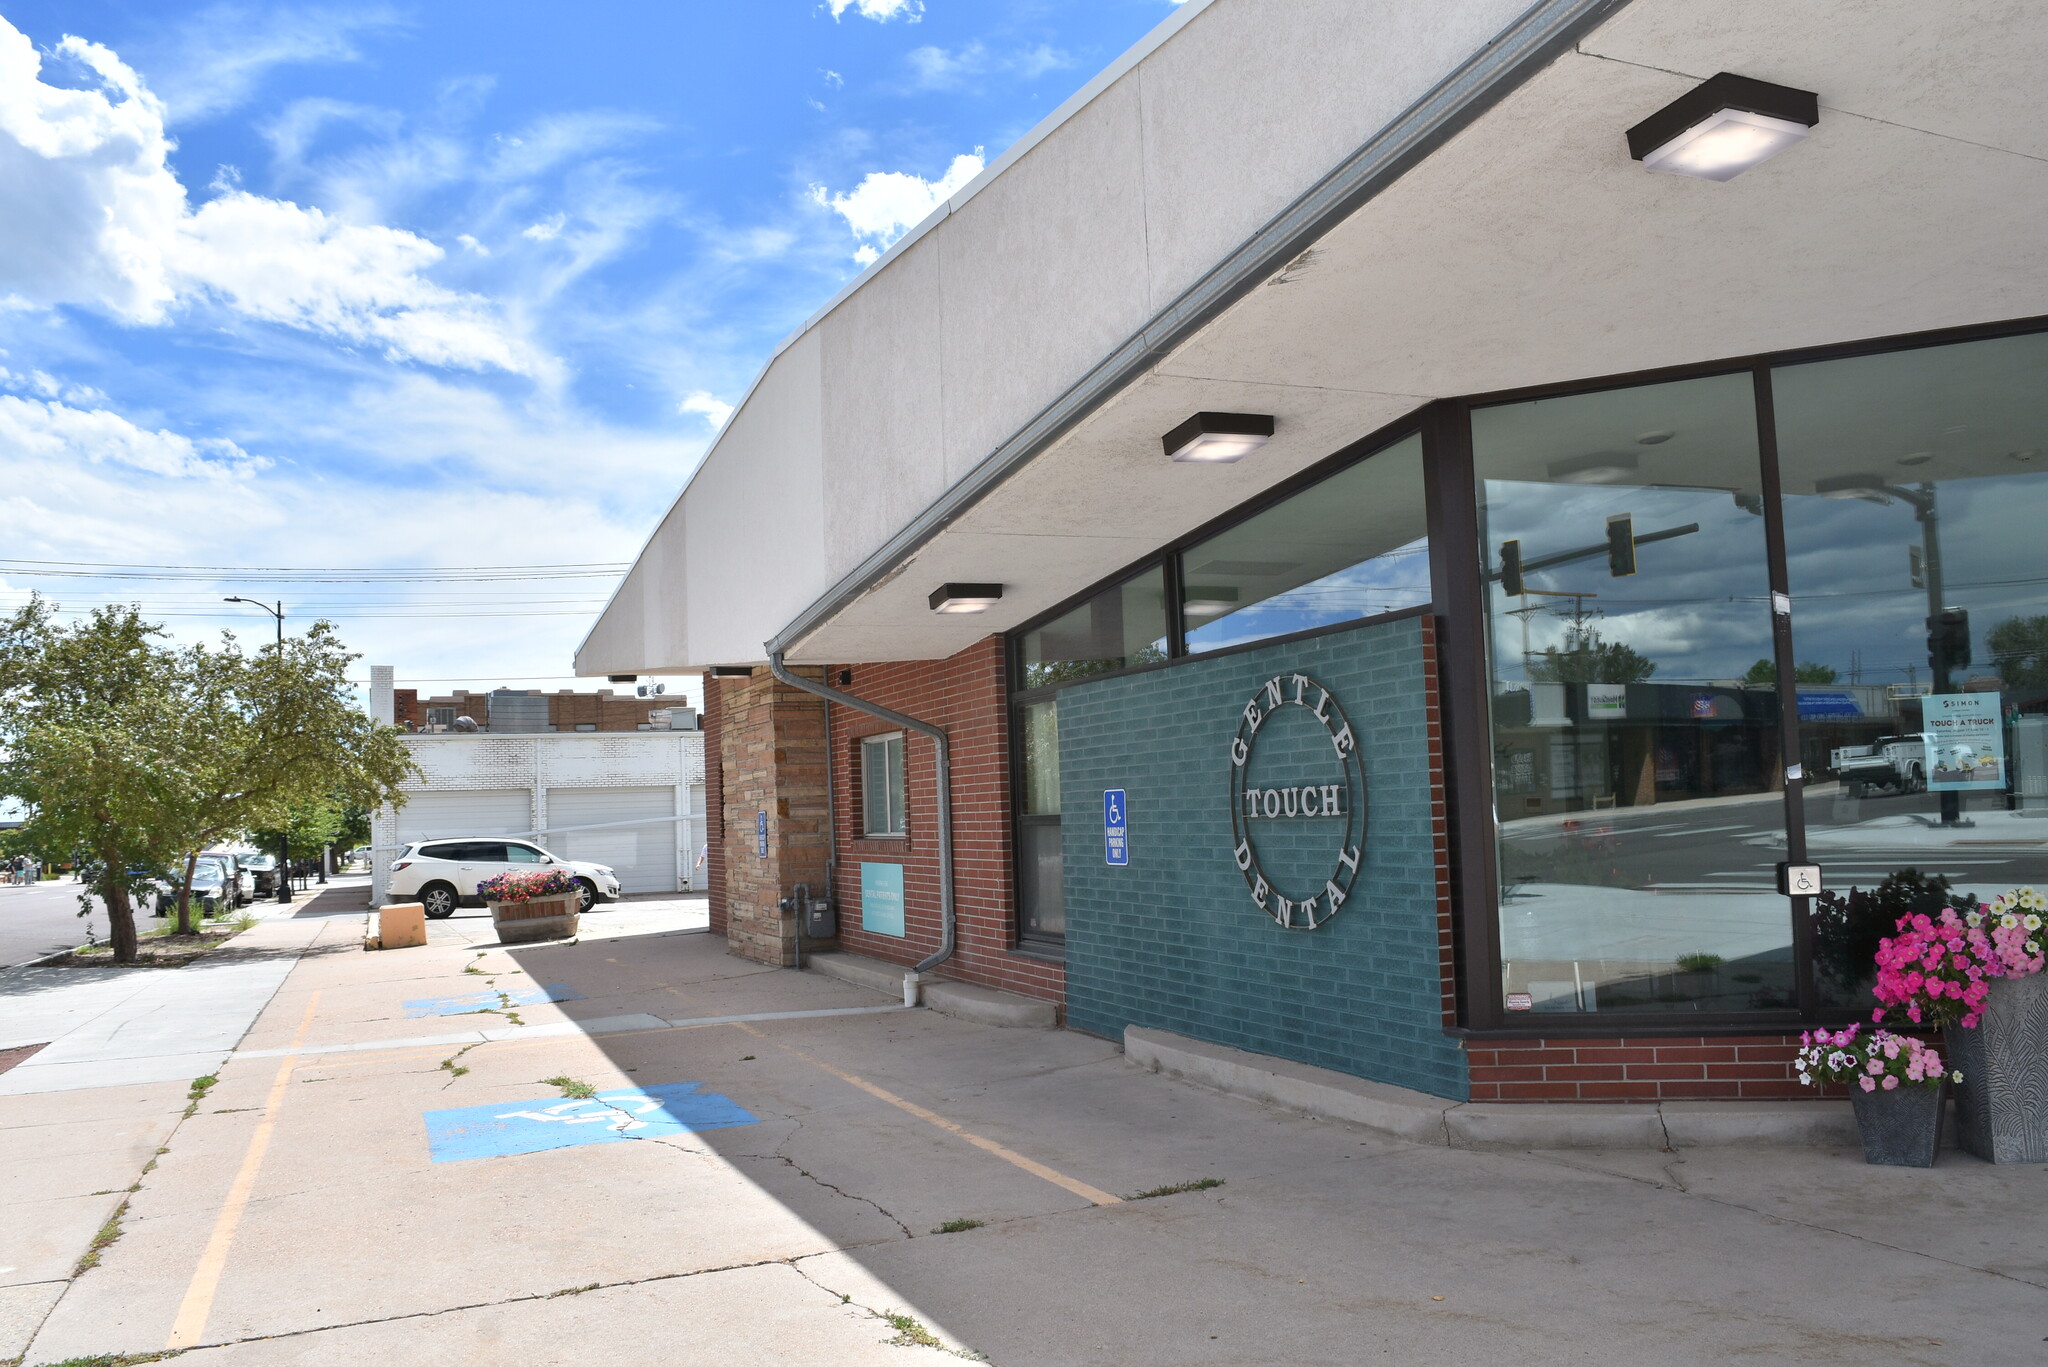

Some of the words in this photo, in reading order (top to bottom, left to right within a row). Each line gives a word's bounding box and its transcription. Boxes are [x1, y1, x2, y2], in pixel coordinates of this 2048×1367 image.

[1231, 673, 1355, 767] GENTLE
[1968, 718, 1994, 726] TRUCK
[1246, 784, 1341, 819] TOUCH
[1107, 826, 1124, 837] HANDICAP
[1108, 838, 1124, 847] PARKING
[1112, 848, 1121, 858] ONLY
[1233, 837, 1360, 930] DENTAL
